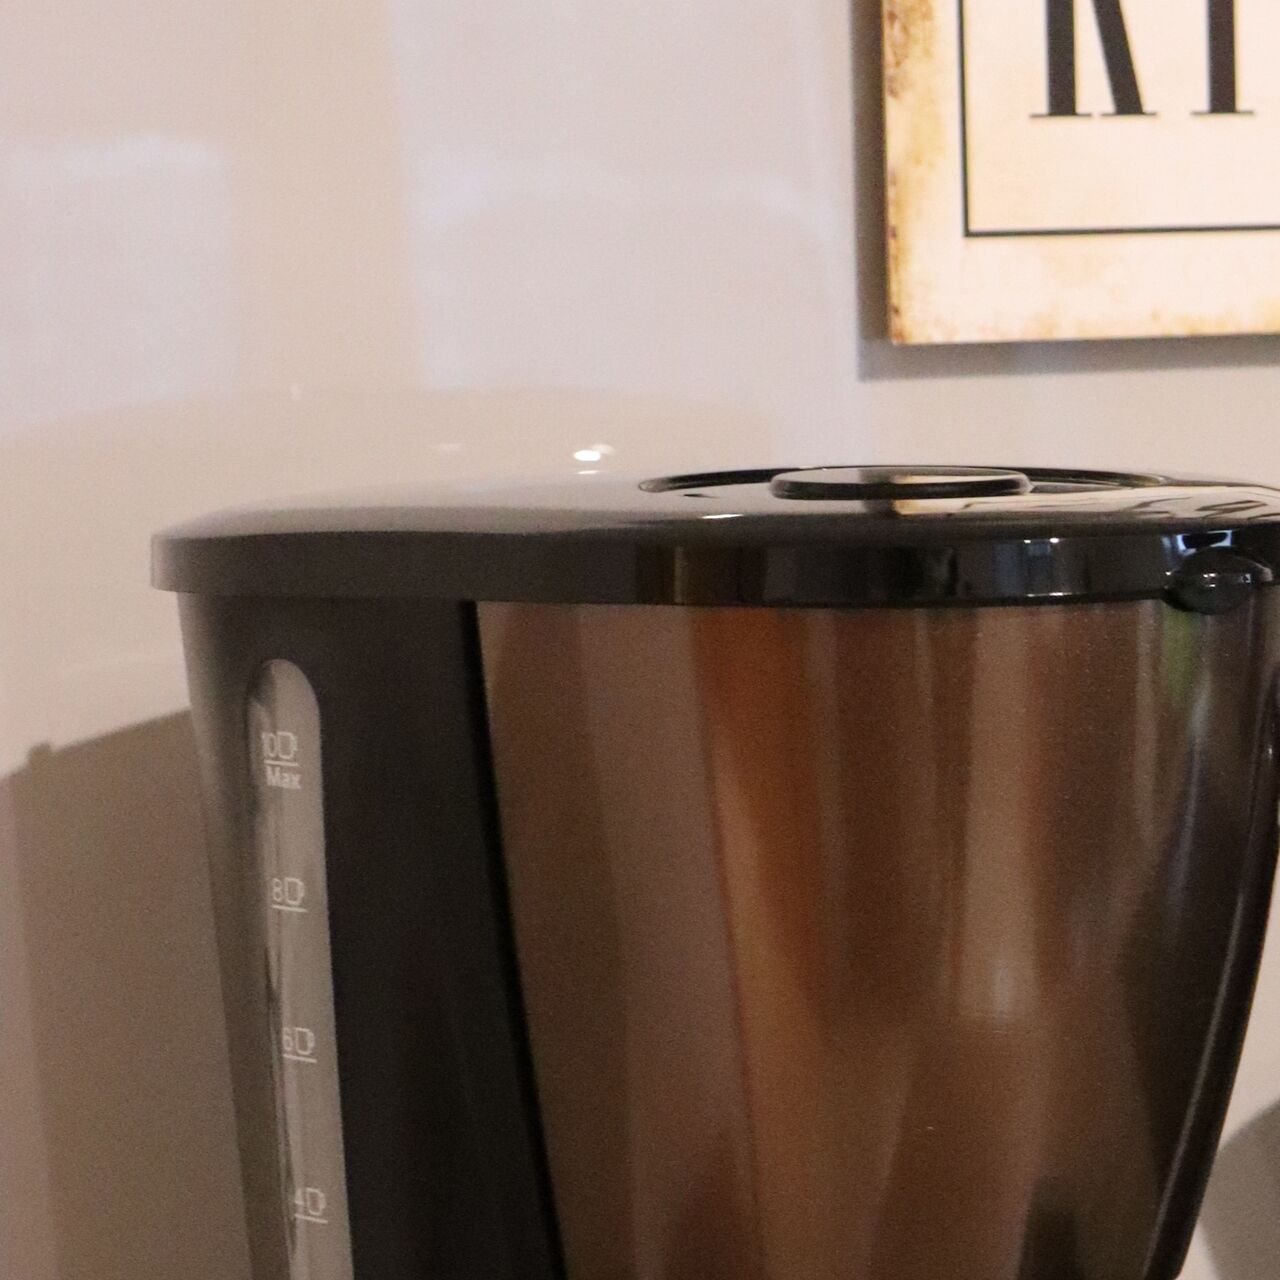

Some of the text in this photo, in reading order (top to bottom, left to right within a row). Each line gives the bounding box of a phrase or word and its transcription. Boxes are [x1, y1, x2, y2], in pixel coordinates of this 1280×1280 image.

[266, 765, 301, 790] Max
[271, 877, 283, 902] 8
[282, 1026, 294, 1051] 6
